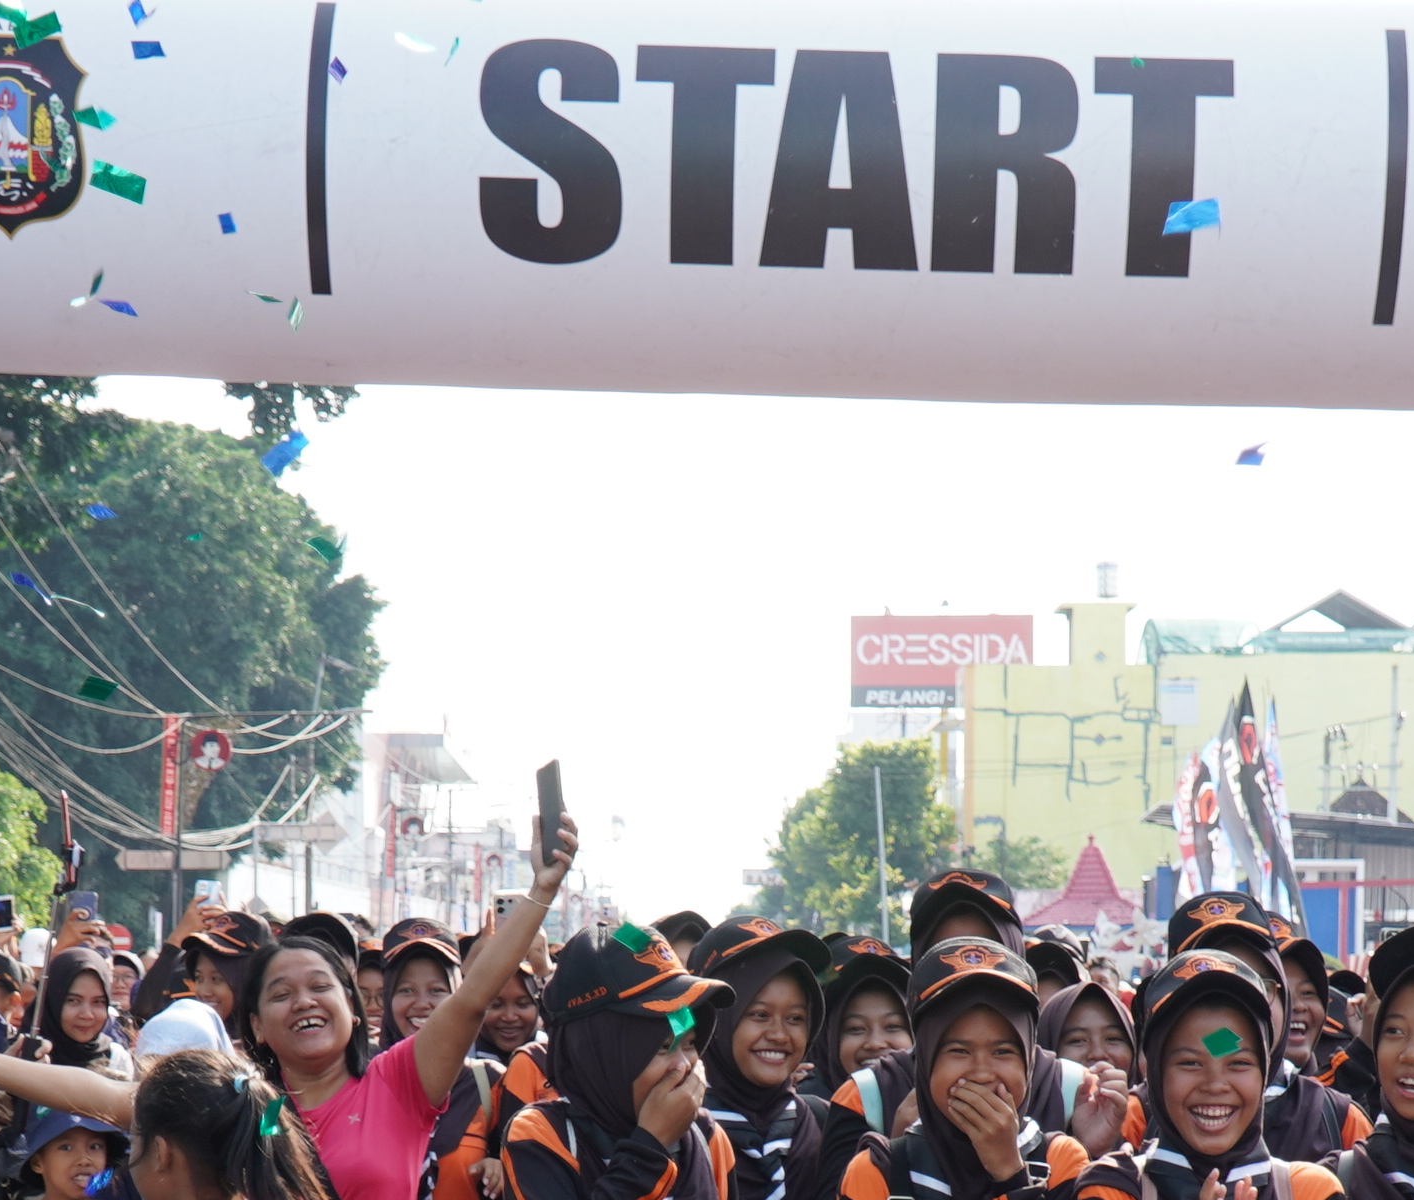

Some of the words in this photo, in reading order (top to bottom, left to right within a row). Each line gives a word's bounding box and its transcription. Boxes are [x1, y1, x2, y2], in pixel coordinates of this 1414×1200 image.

[479, 37, 1236, 278] START
[855, 633, 1030, 666] CRESSIDA
[864, 690, 947, 706] PELANGI
